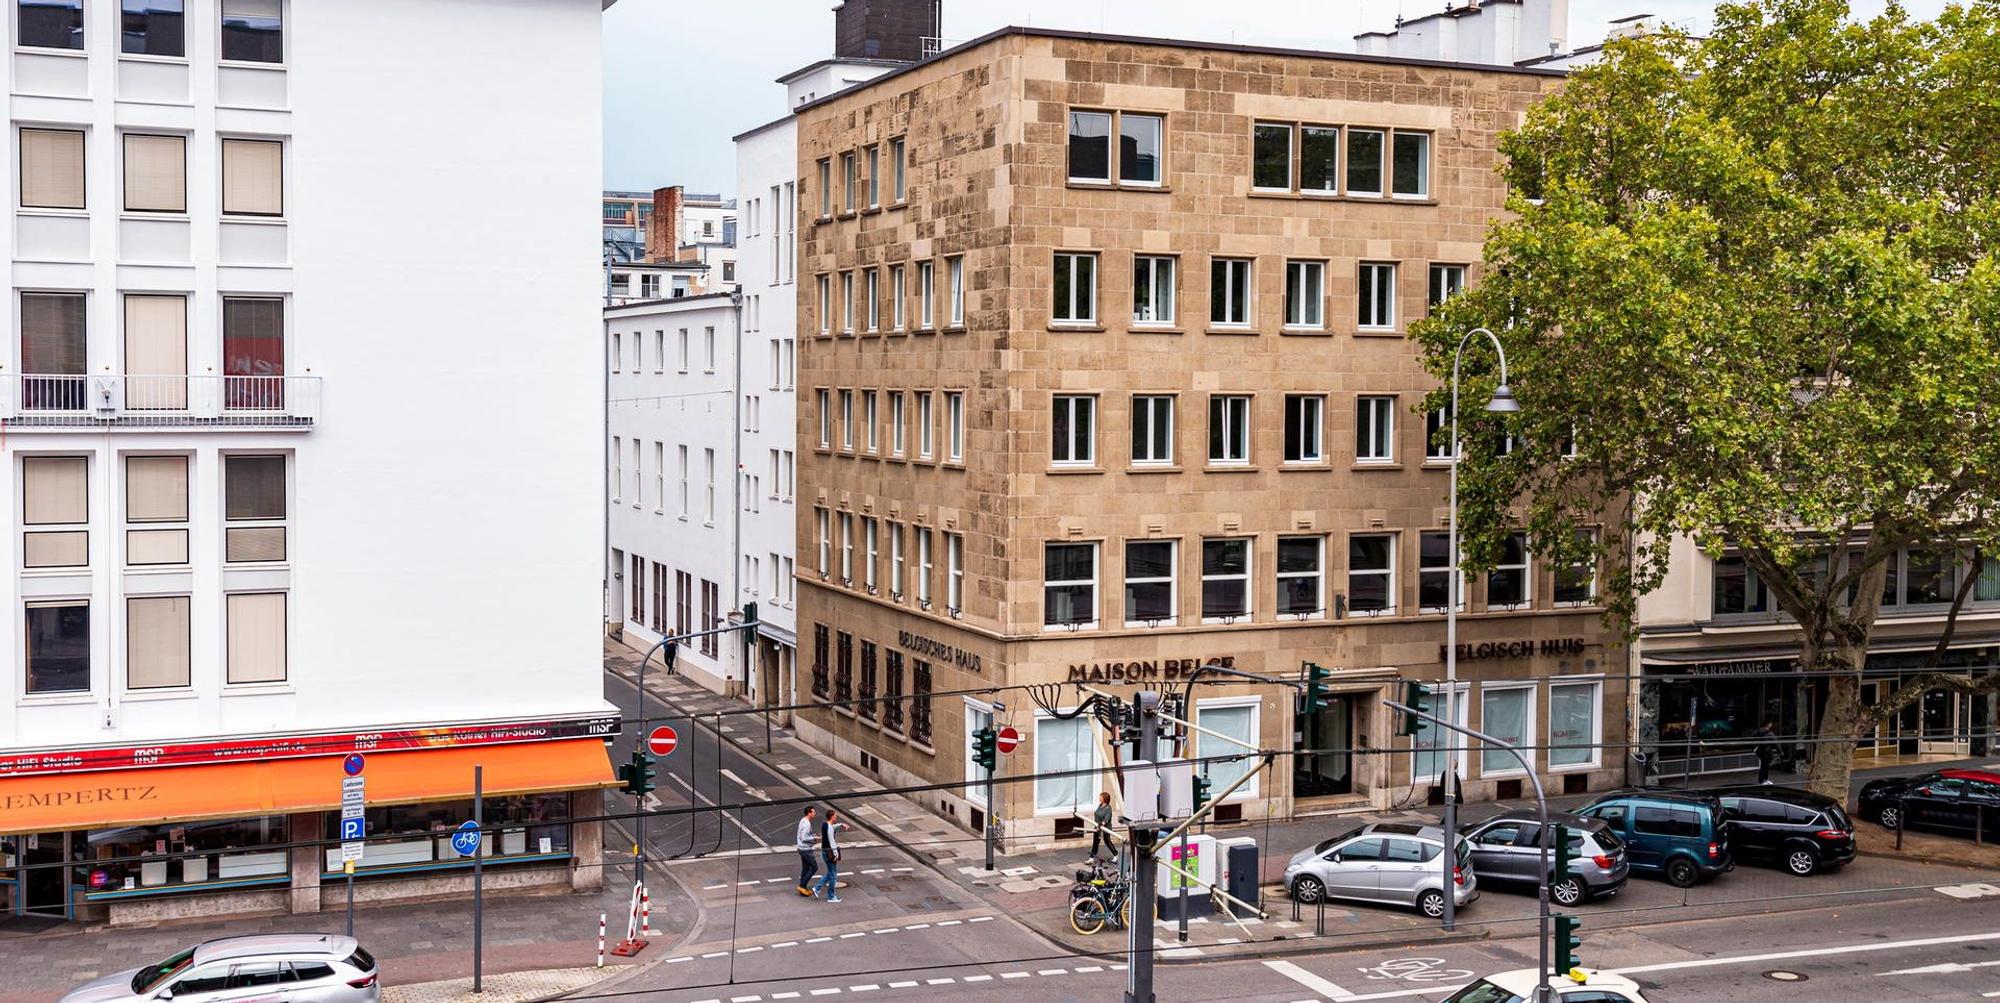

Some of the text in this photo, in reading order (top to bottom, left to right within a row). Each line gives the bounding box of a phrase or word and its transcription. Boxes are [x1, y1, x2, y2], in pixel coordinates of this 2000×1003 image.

[898, 630, 982, 673] BELGISCHES HAUS
[1540, 638, 1585, 657] HUIS
[1067, 660, 1158, 682] MAISON
[0, 786, 157, 810] EMPERTZ
[345, 821, 358, 839] P
